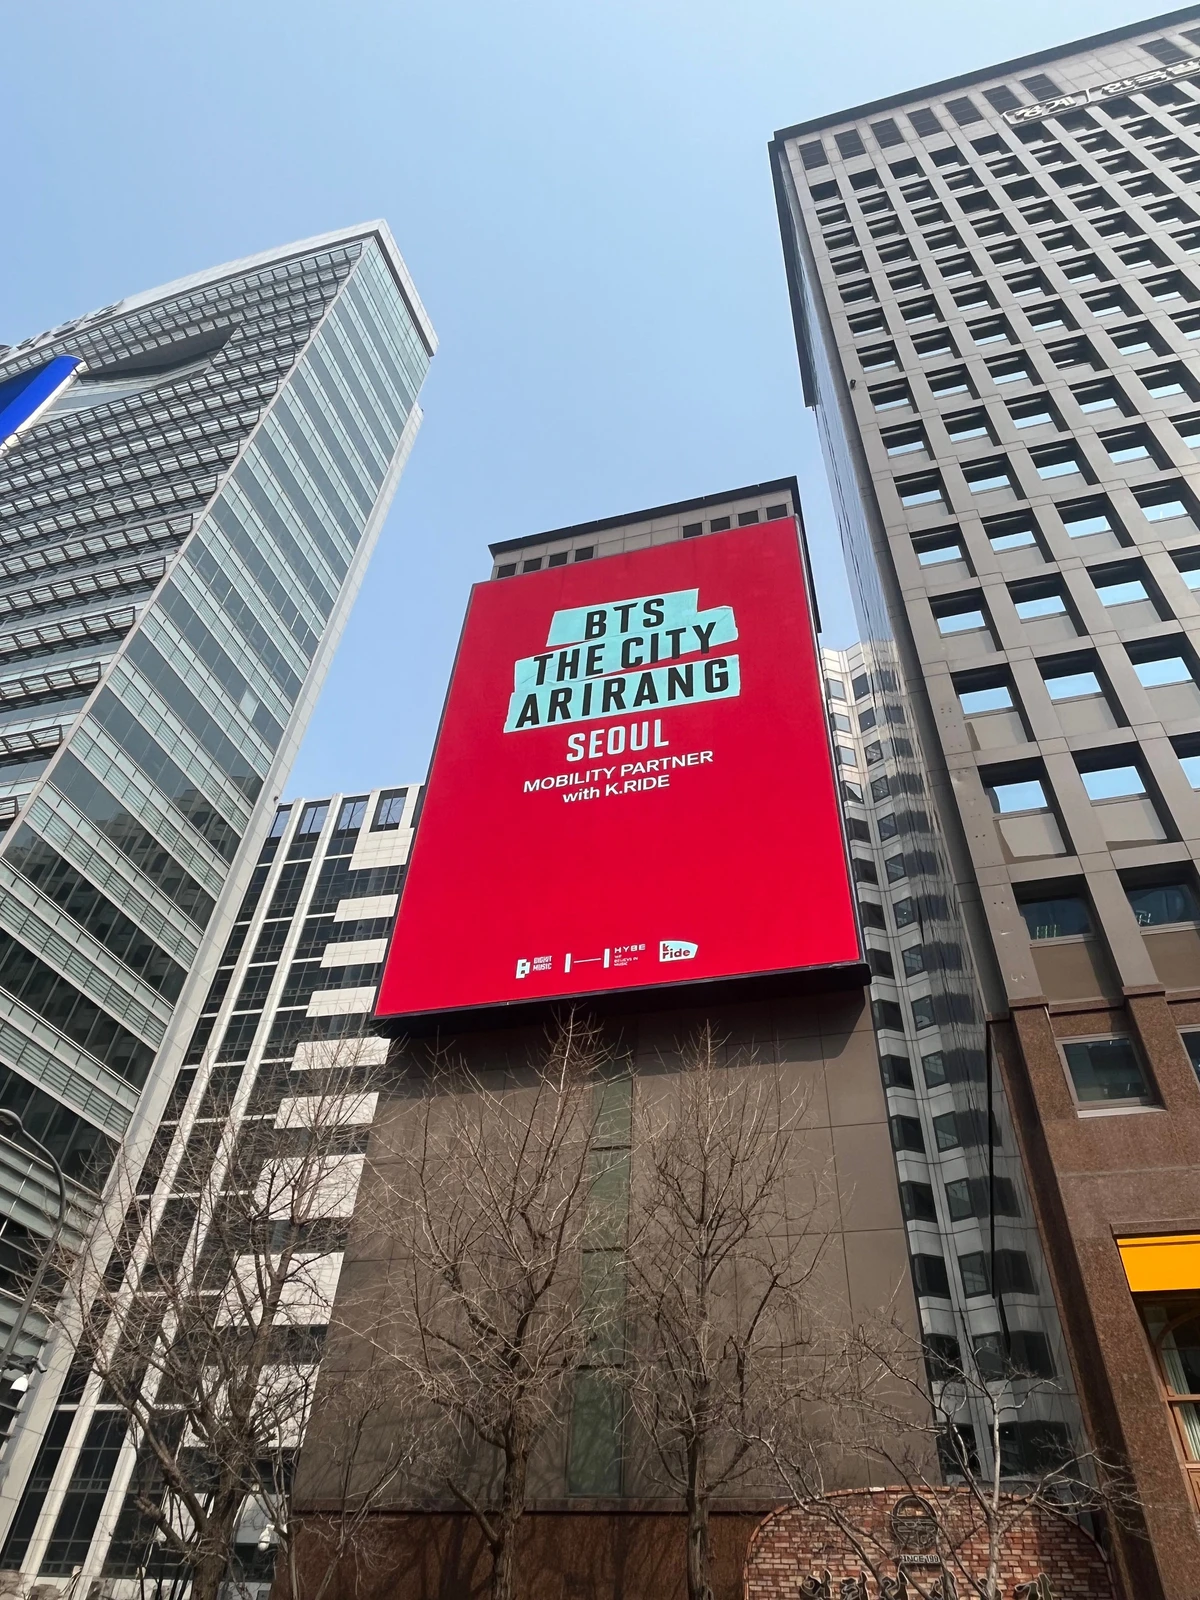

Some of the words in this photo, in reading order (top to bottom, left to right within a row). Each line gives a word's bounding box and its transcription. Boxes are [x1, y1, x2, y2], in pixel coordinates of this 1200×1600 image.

[585, 597, 665, 639] BTS
[533, 644, 606, 686] THE
[620, 621, 717, 669] CITY
[514, 658, 730, 729] ARIRANG
[566, 718, 670, 762] SEOUL
[523, 765, 617, 793] MOBILITY
[620, 750, 714, 777] PARTNER
[562, 786, 601, 803] with
[605, 774, 671, 797] K.RIDE
[532, 962, 553, 972] MUSIC
[614, 943, 646, 954] HYBE
[662, 948, 691, 959] ride
